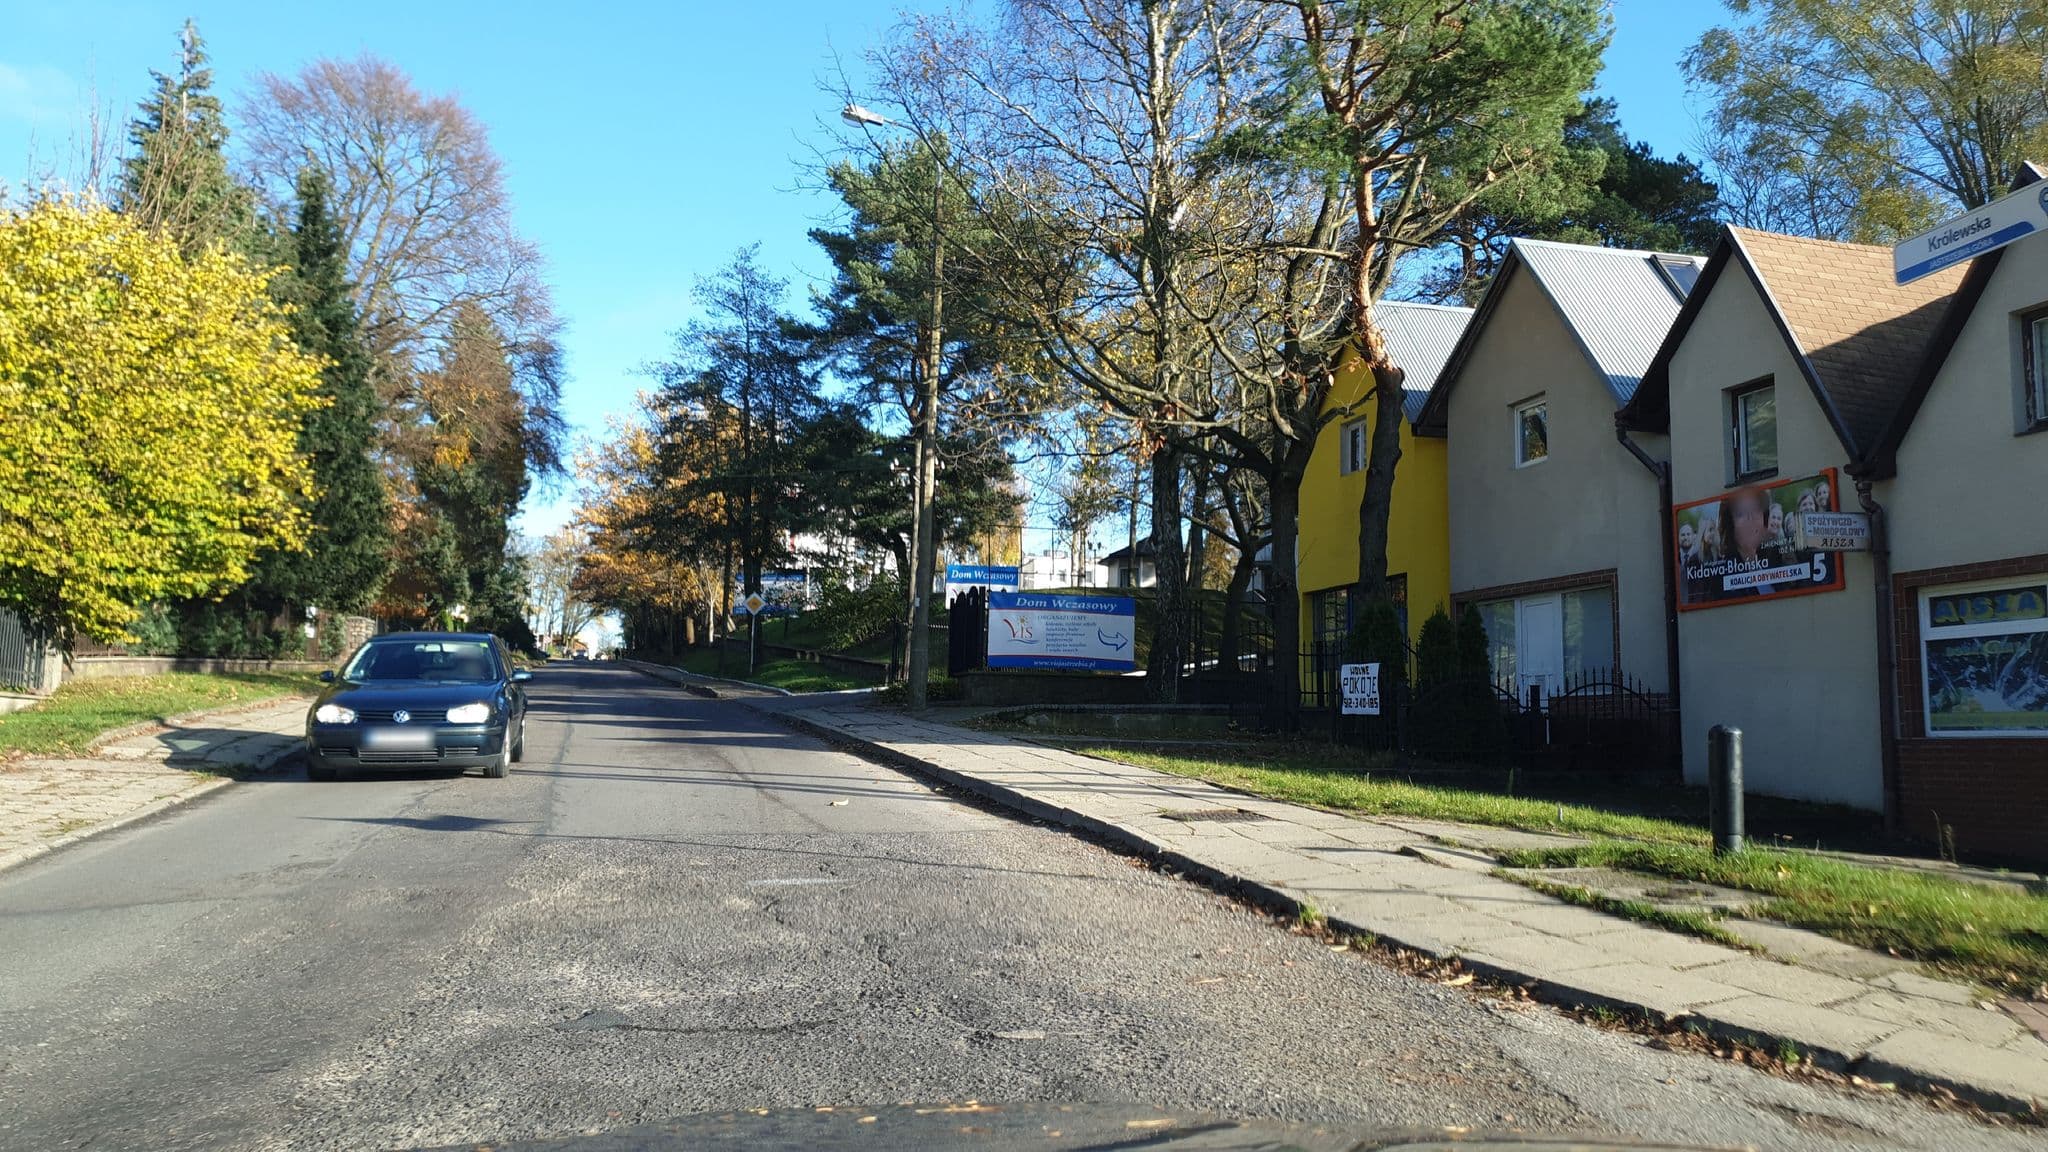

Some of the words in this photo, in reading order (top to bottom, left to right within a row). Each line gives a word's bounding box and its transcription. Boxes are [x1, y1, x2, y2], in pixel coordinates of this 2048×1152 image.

[1928, 216, 1992, 252] Królewska
[1821, 538, 1855, 548] AISZA
[951, 569, 972, 579] Dom
[1687, 556, 1769, 580] Kidawa-Błońska
[1730, 575, 1757, 586] KOALICJA
[1757, 567, 1803, 582] OBYWATELSKA
[1812, 552, 1827, 582] 5
[1015, 597, 1047, 608] Dom
[1052, 599, 1117, 612] Wczasowy
[1343, 676, 1377, 697] POKOJE
